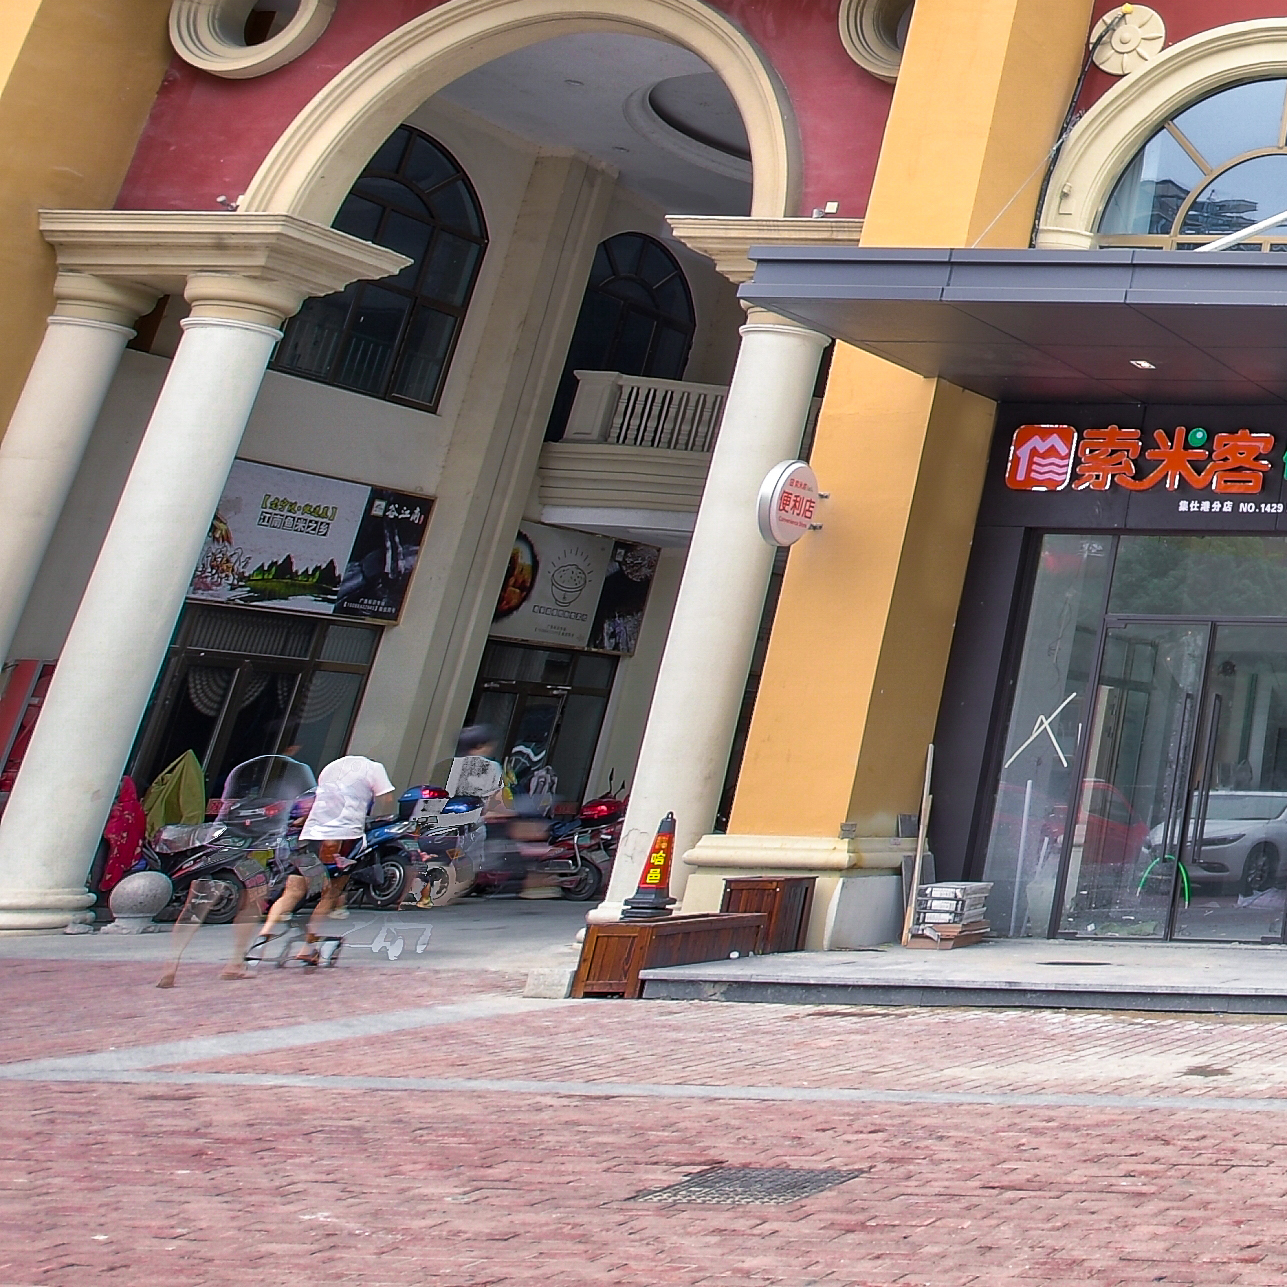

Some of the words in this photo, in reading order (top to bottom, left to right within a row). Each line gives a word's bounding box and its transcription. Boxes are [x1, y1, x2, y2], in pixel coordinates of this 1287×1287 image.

[1072, 425, 1275, 494] 索米客
[778, 491, 815, 519] 便利店
[1178, 501, 1233, 513] 集仕港分店
[1239, 503, 1284, 514] NO.1429
[258, 512, 331, 537] 江南鱼米之乡
